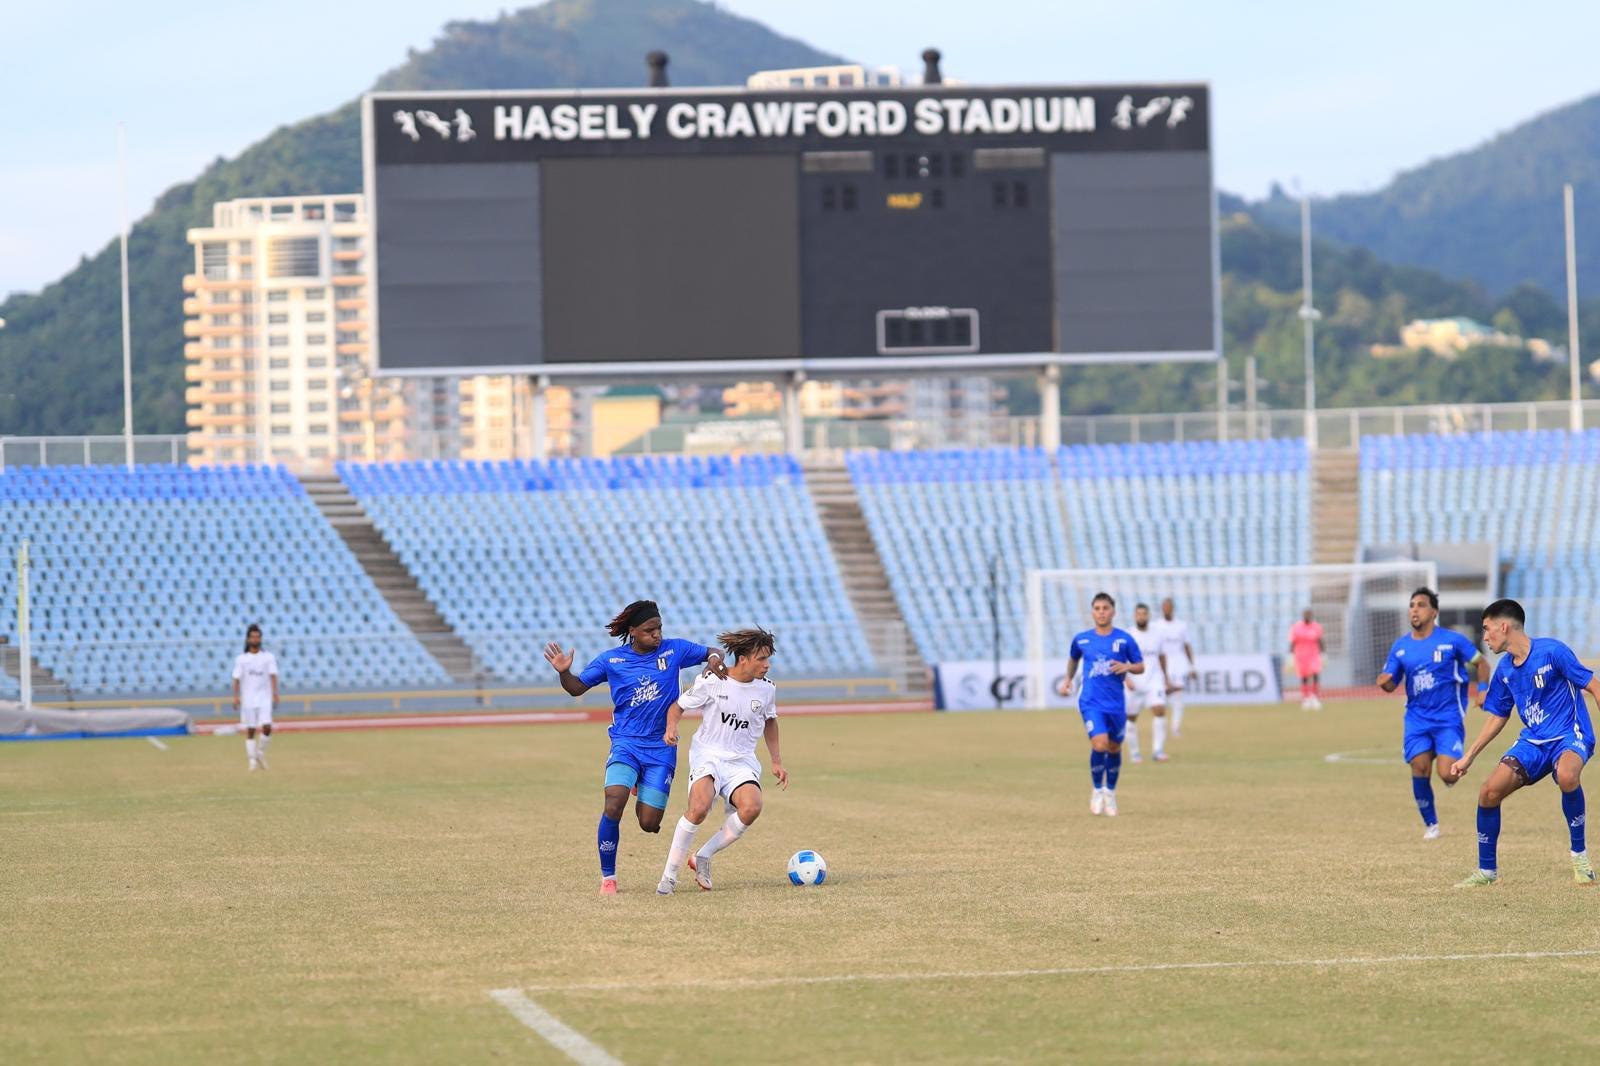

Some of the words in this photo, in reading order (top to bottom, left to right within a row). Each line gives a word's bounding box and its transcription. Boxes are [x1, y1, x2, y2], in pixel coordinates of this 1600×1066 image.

[493, 103, 657, 141] HASELY
[665, 99, 908, 140] CRAWFORD
[914, 96, 1097, 135] STADIUM
[721, 711, 750, 731] Viya
